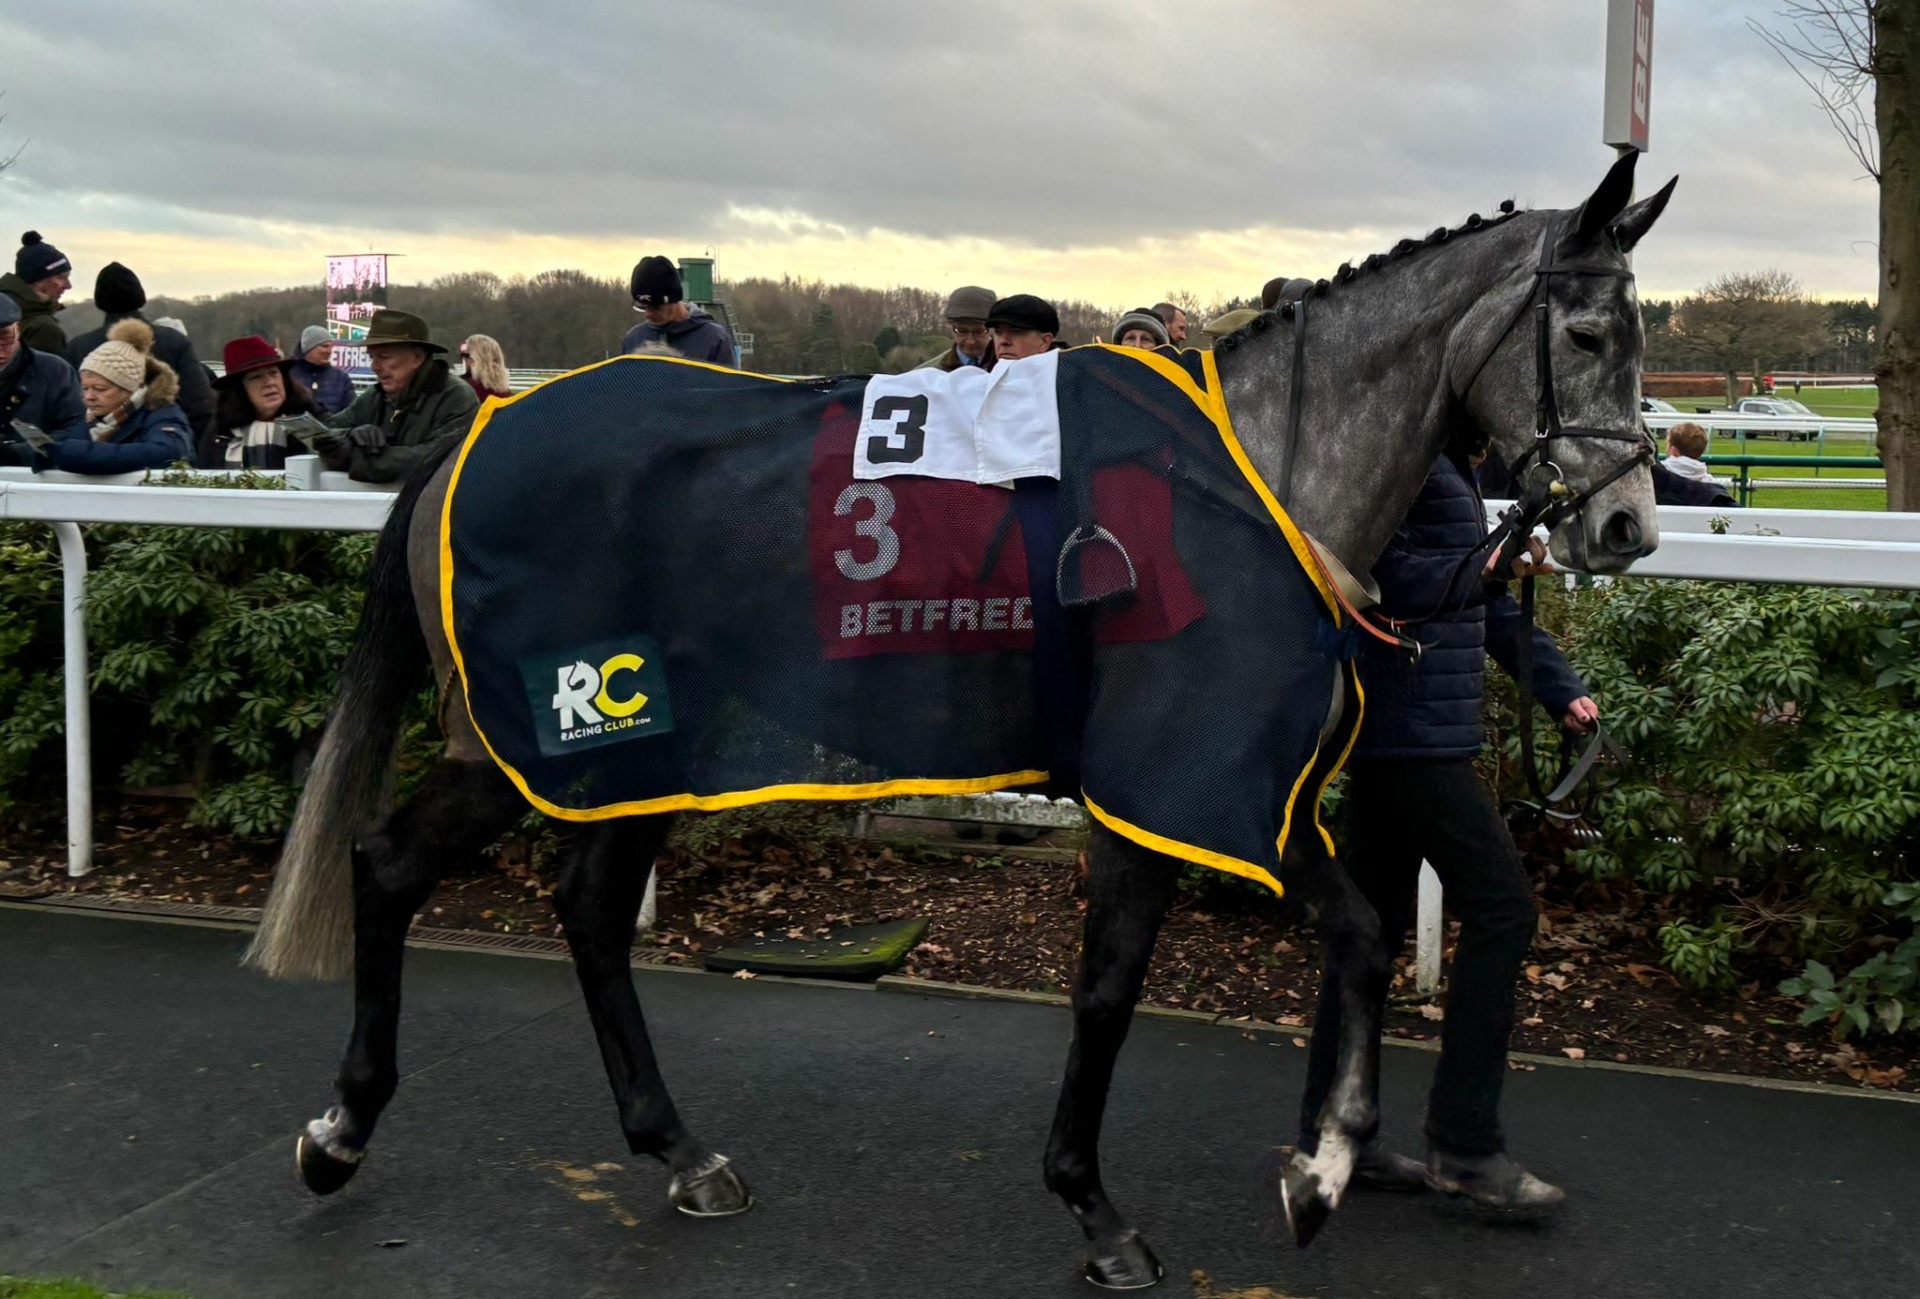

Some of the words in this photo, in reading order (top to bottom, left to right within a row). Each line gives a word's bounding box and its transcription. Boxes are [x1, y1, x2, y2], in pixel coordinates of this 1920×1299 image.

[1634, 0, 1650, 126] BE
[867, 394, 929, 464] 3
[833, 481, 900, 581] 3
[552, 653, 649, 730] RC
[561, 725, 602, 741] RACING
